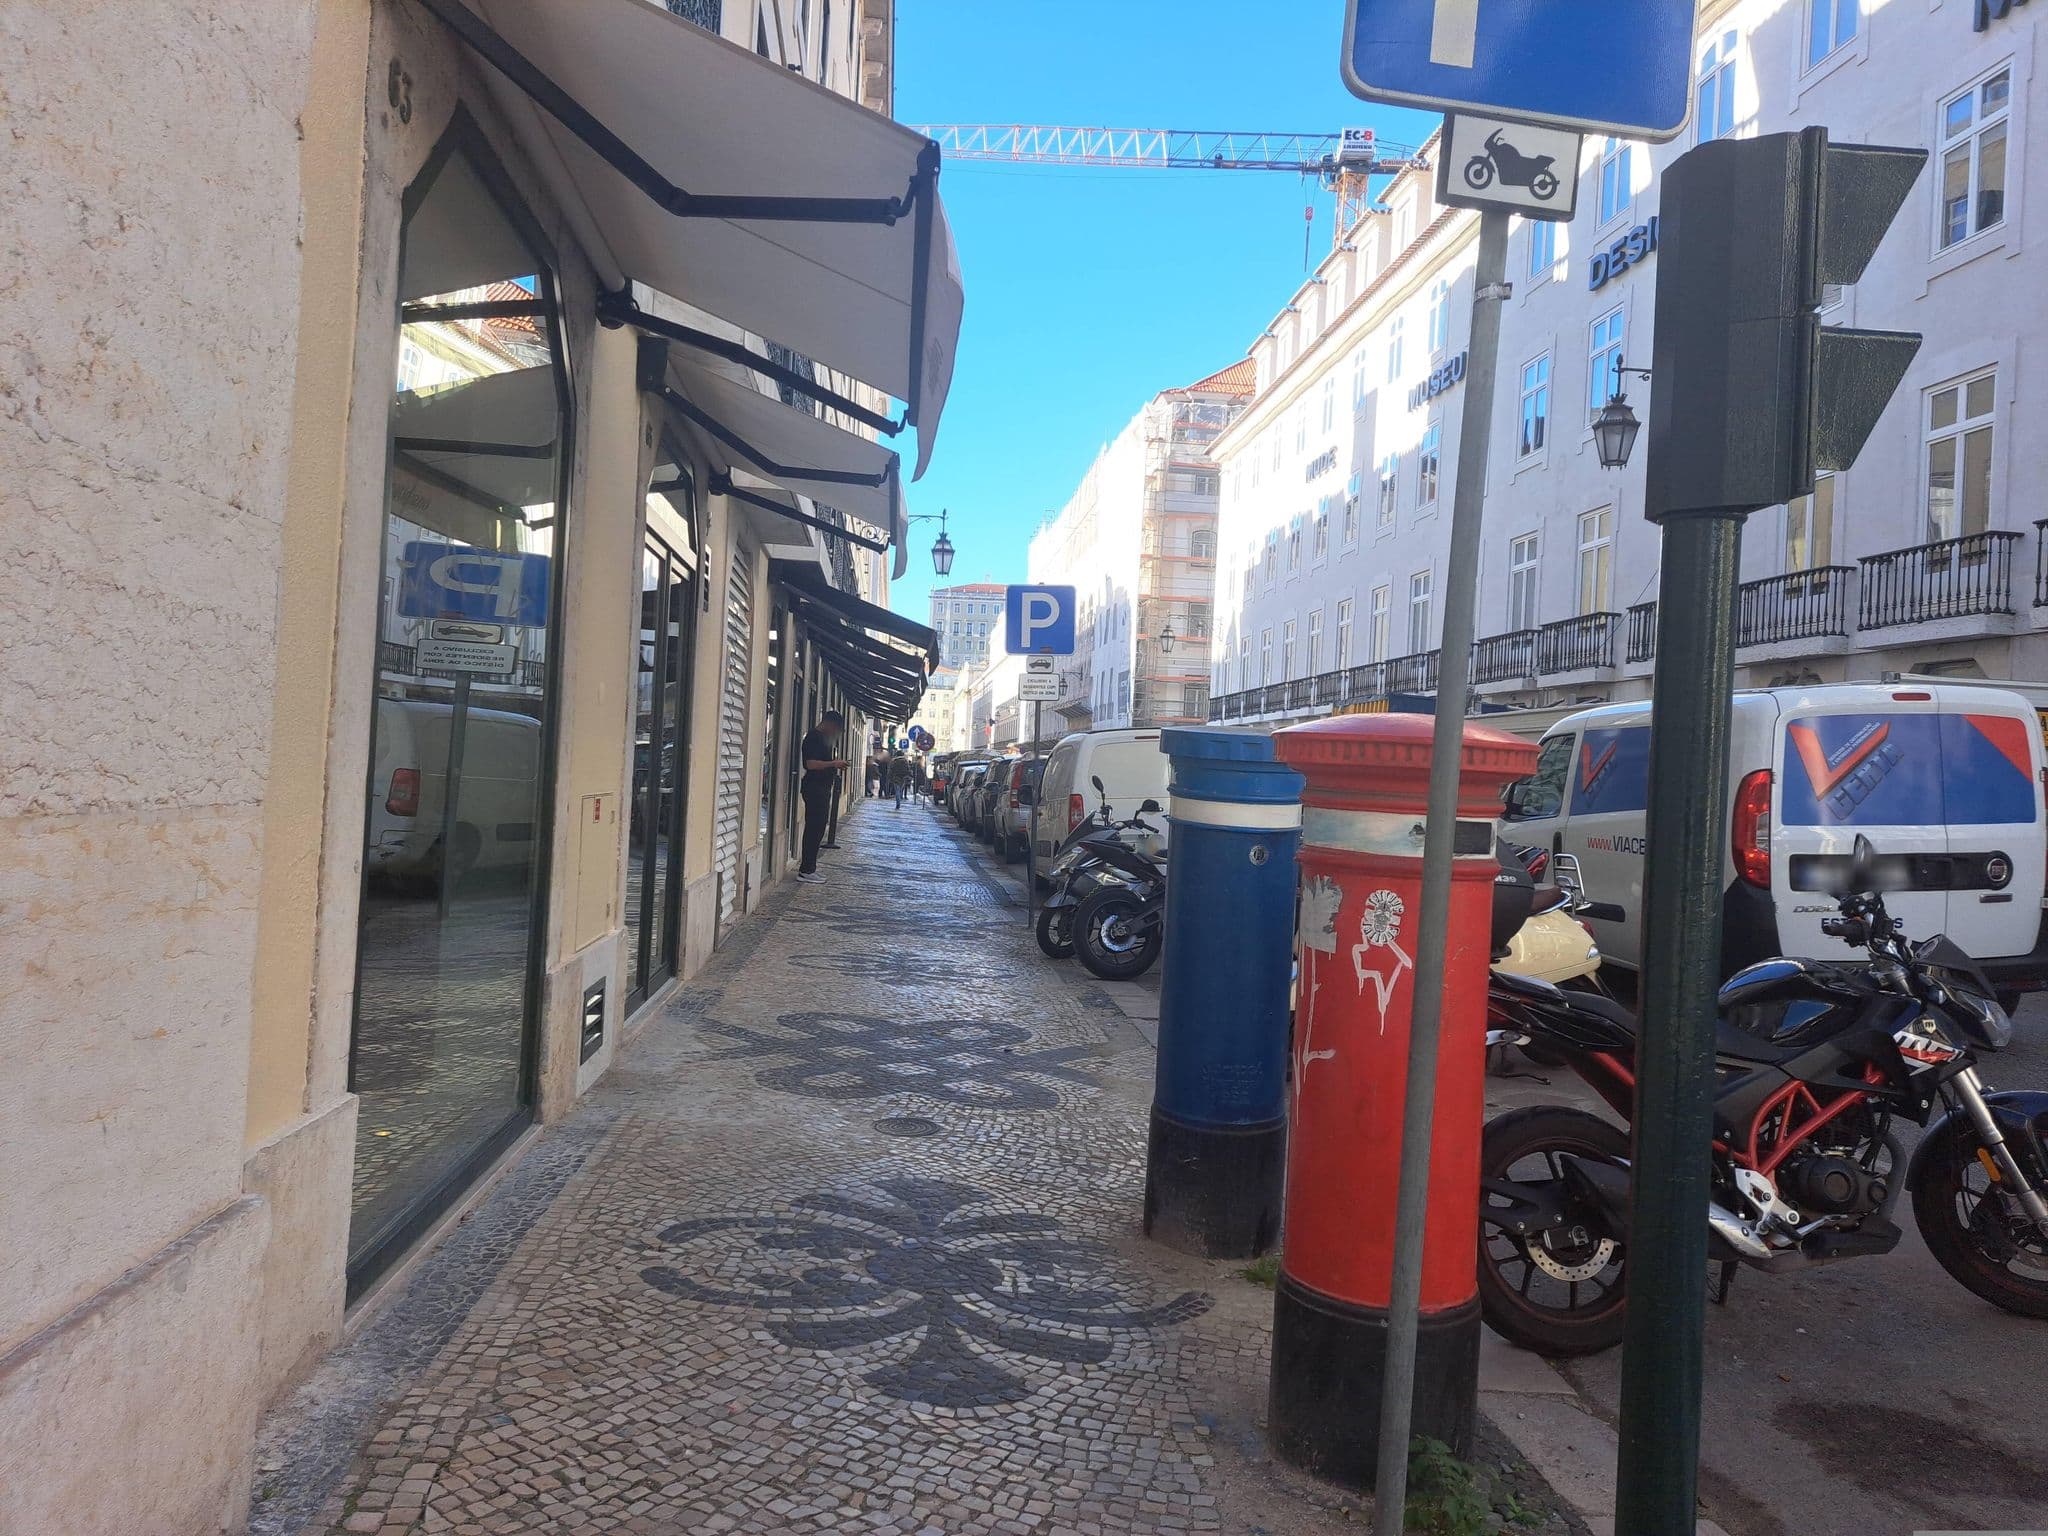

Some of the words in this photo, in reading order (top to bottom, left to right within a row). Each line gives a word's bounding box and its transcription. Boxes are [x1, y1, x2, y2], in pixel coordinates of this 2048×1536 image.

[1344, 130, 1373, 141] EC-B
[1588, 216, 1660, 291] DESI
[1408, 351, 1468, 412] MUSEU
[1021, 592, 1060, 648] P
